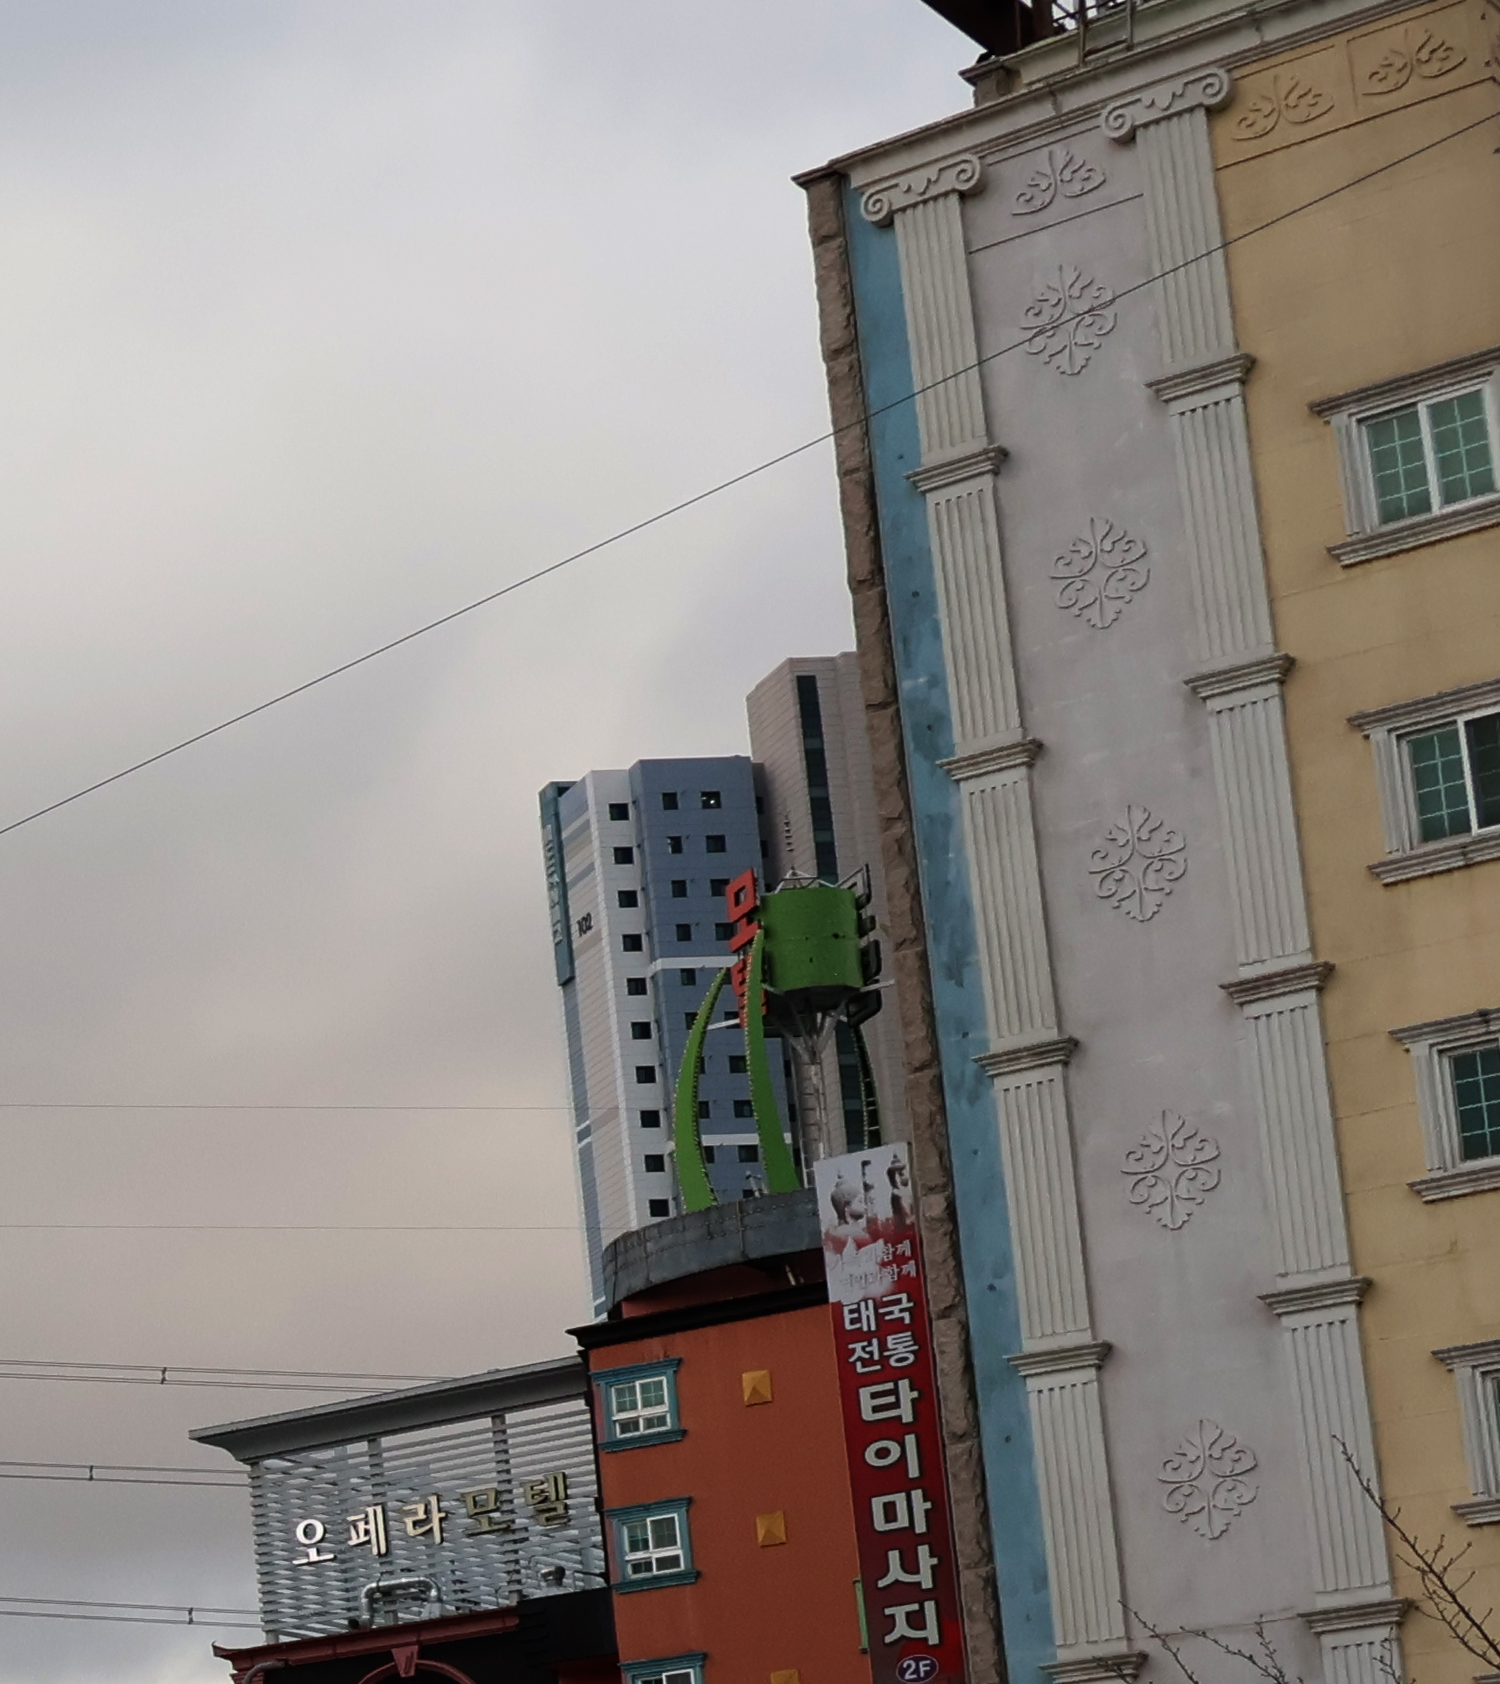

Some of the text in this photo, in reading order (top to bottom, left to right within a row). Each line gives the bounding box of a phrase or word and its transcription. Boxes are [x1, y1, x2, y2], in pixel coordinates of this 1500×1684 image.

[577, 914, 592, 937] 102
[843, 1292, 914, 1332] 태국
[848, 1331, 919, 1373] 전통
[292, 1471, 570, 1565] 오페라모텔
[859, 1378, 940, 1646] 타이마사지
[902, 1659, 931, 1680] 2F
